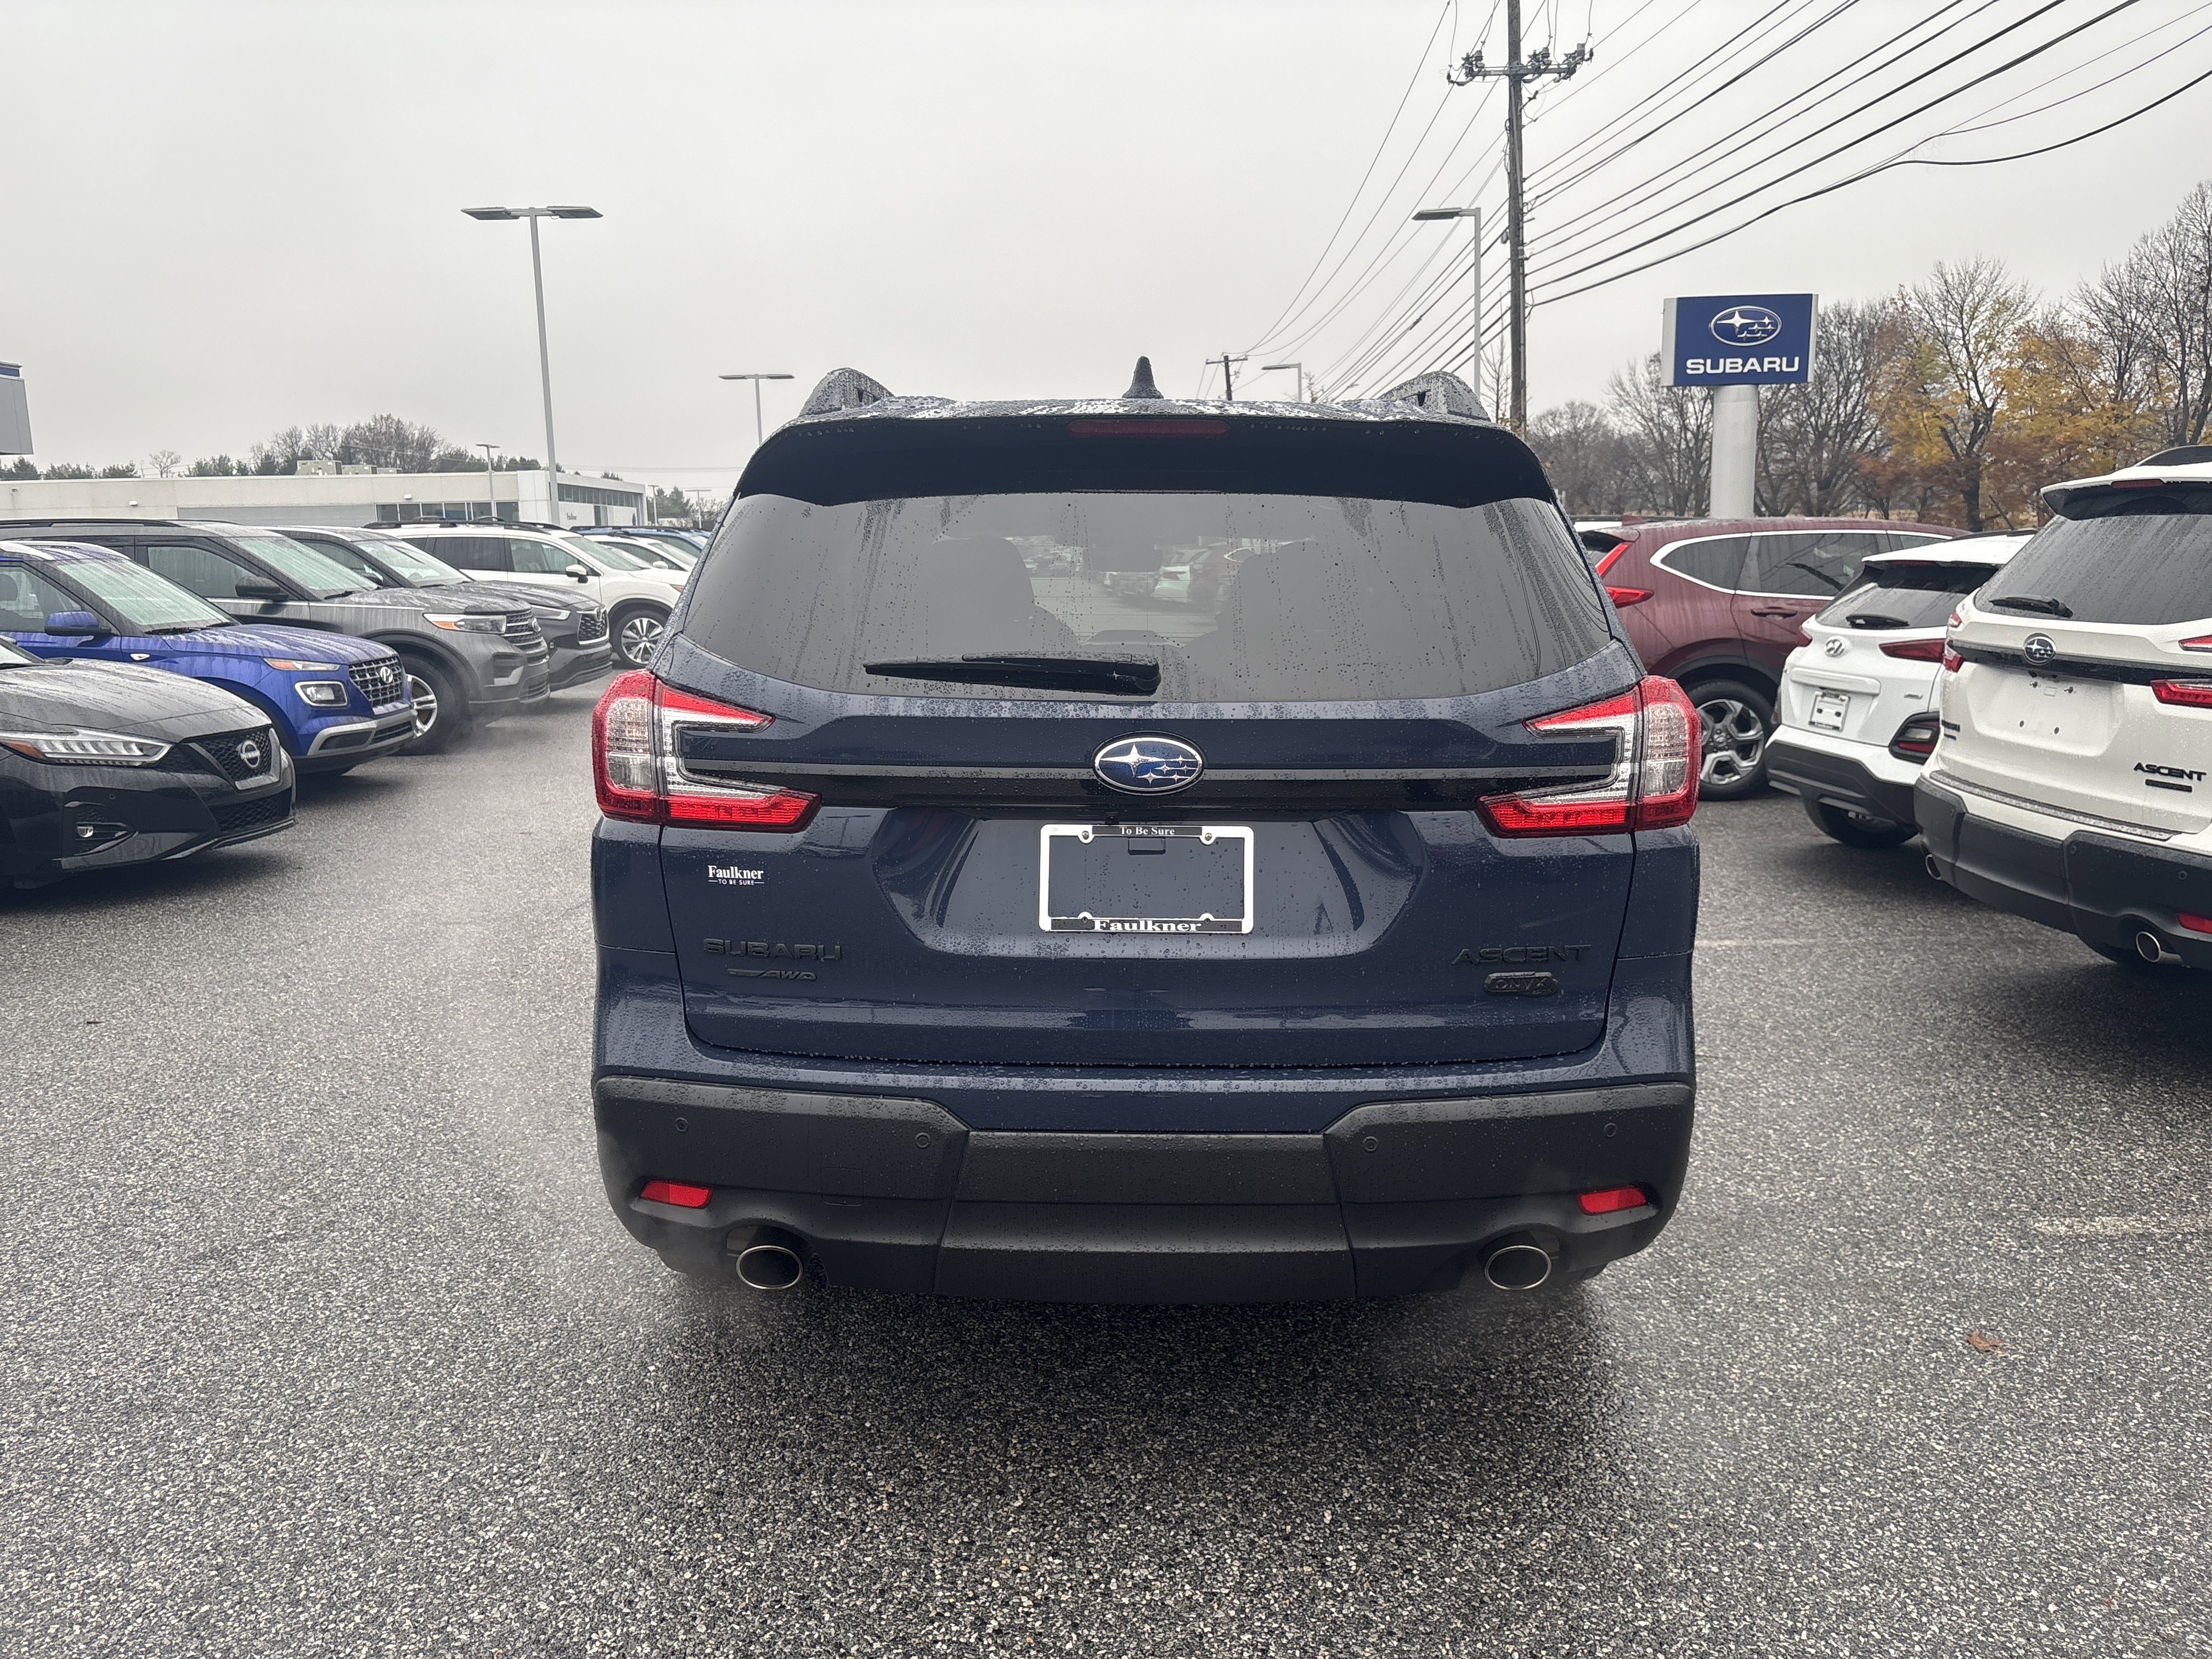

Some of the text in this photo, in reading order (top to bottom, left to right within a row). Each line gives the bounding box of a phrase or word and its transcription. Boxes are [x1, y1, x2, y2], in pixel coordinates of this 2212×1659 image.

[1685, 356, 1800, 375] SUBARU
[2133, 762, 2207, 781] ASCENT
[1119, 826, 1132, 834] To
[1151, 827, 1175, 835] Sure
[708, 865, 764, 879] Faulkner
[1092, 919, 1202, 932] Faulkner
[703, 938, 842, 961] SUBARU
[1451, 944, 1592, 964] ASCENT
[757, 969, 817, 981] AWD
[1496, 978, 1548, 990] ONYX
